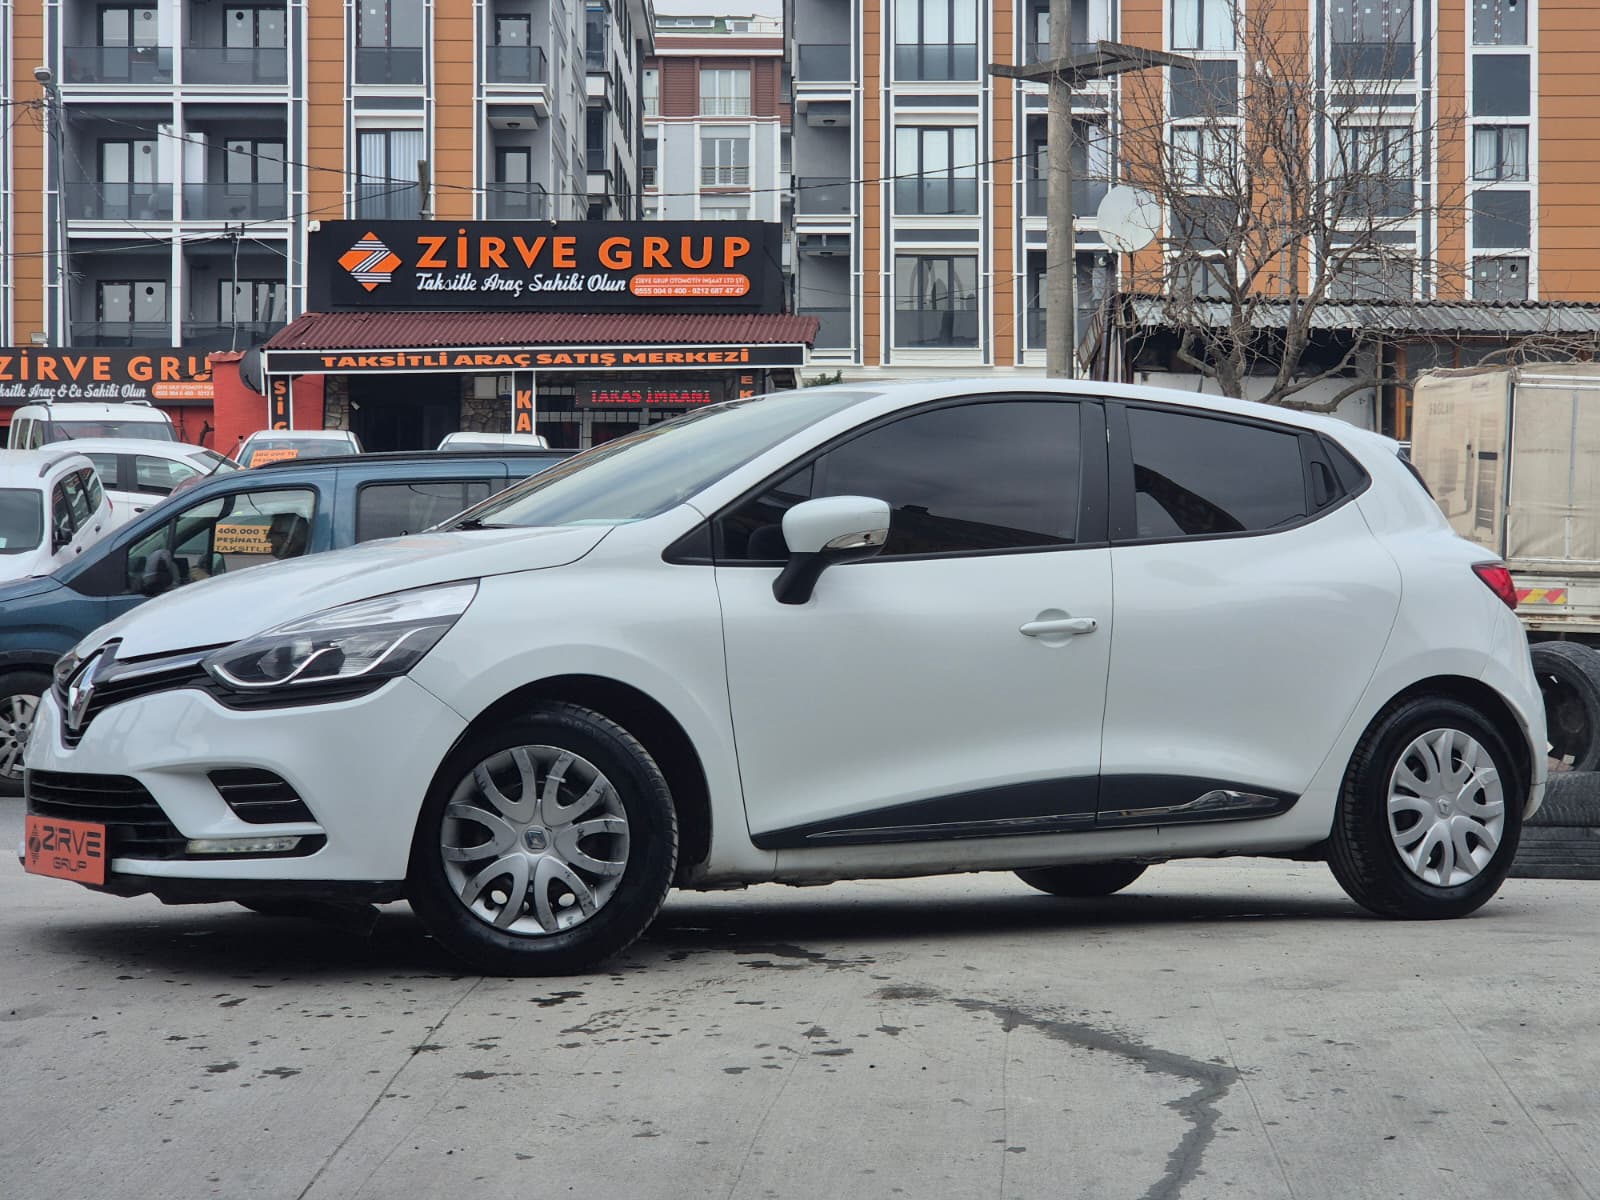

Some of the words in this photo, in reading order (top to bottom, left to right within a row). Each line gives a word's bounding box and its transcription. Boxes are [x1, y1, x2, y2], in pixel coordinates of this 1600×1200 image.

[416, 228, 577, 269] ZİRVE
[598, 236, 750, 270] GRUP
[416, 272, 477, 292] Taksitle
[481, 273, 524, 298] Araç
[529, 272, 585, 292] Sahibi
[587, 273, 626, 292] Olun
[0, 349, 112, 381] ZİRVE
[320, 352, 448, 367] TAKSİTLİ
[453, 353, 531, 367] ARAÇ
[536, 353, 617, 367] SATIŞ
[622, 348, 749, 363] MERKEZİ
[57, 383, 68, 397] &
[84, 383, 120, 398] Sahibi
[121, 383, 146, 398] Olun
[53, 857, 87, 872] GRUP
